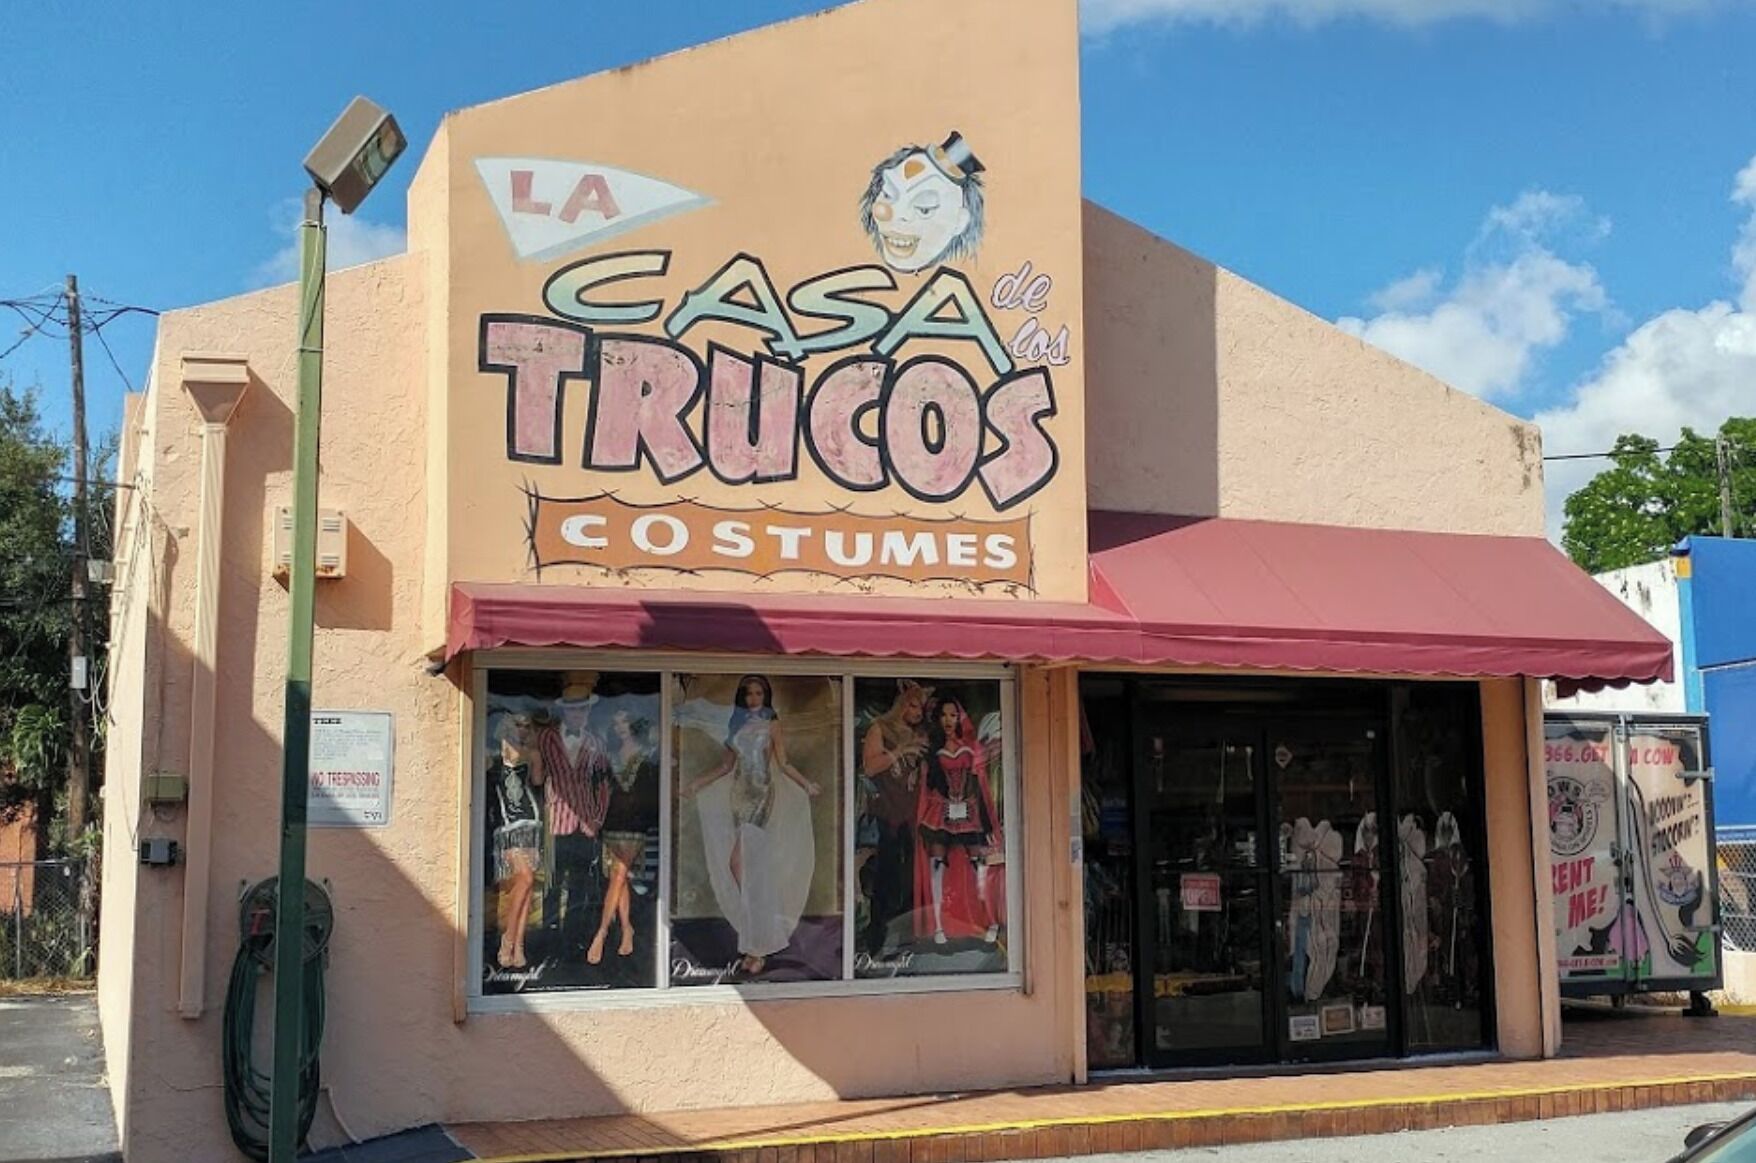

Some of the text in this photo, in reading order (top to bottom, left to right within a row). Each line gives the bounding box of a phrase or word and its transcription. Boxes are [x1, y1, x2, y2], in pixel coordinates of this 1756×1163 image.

[510, 170, 622, 223] LA
[543, 250, 1014, 373] CASA
[990, 260, 1052, 313] de
[1008, 316, 1071, 366] los
[479, 313, 1058, 512] TRUCOS
[560, 513, 1018, 570] COSTUMES
[328, 771, 381, 786] TRESPASSING
[1568, 884, 1608, 929] ME!
